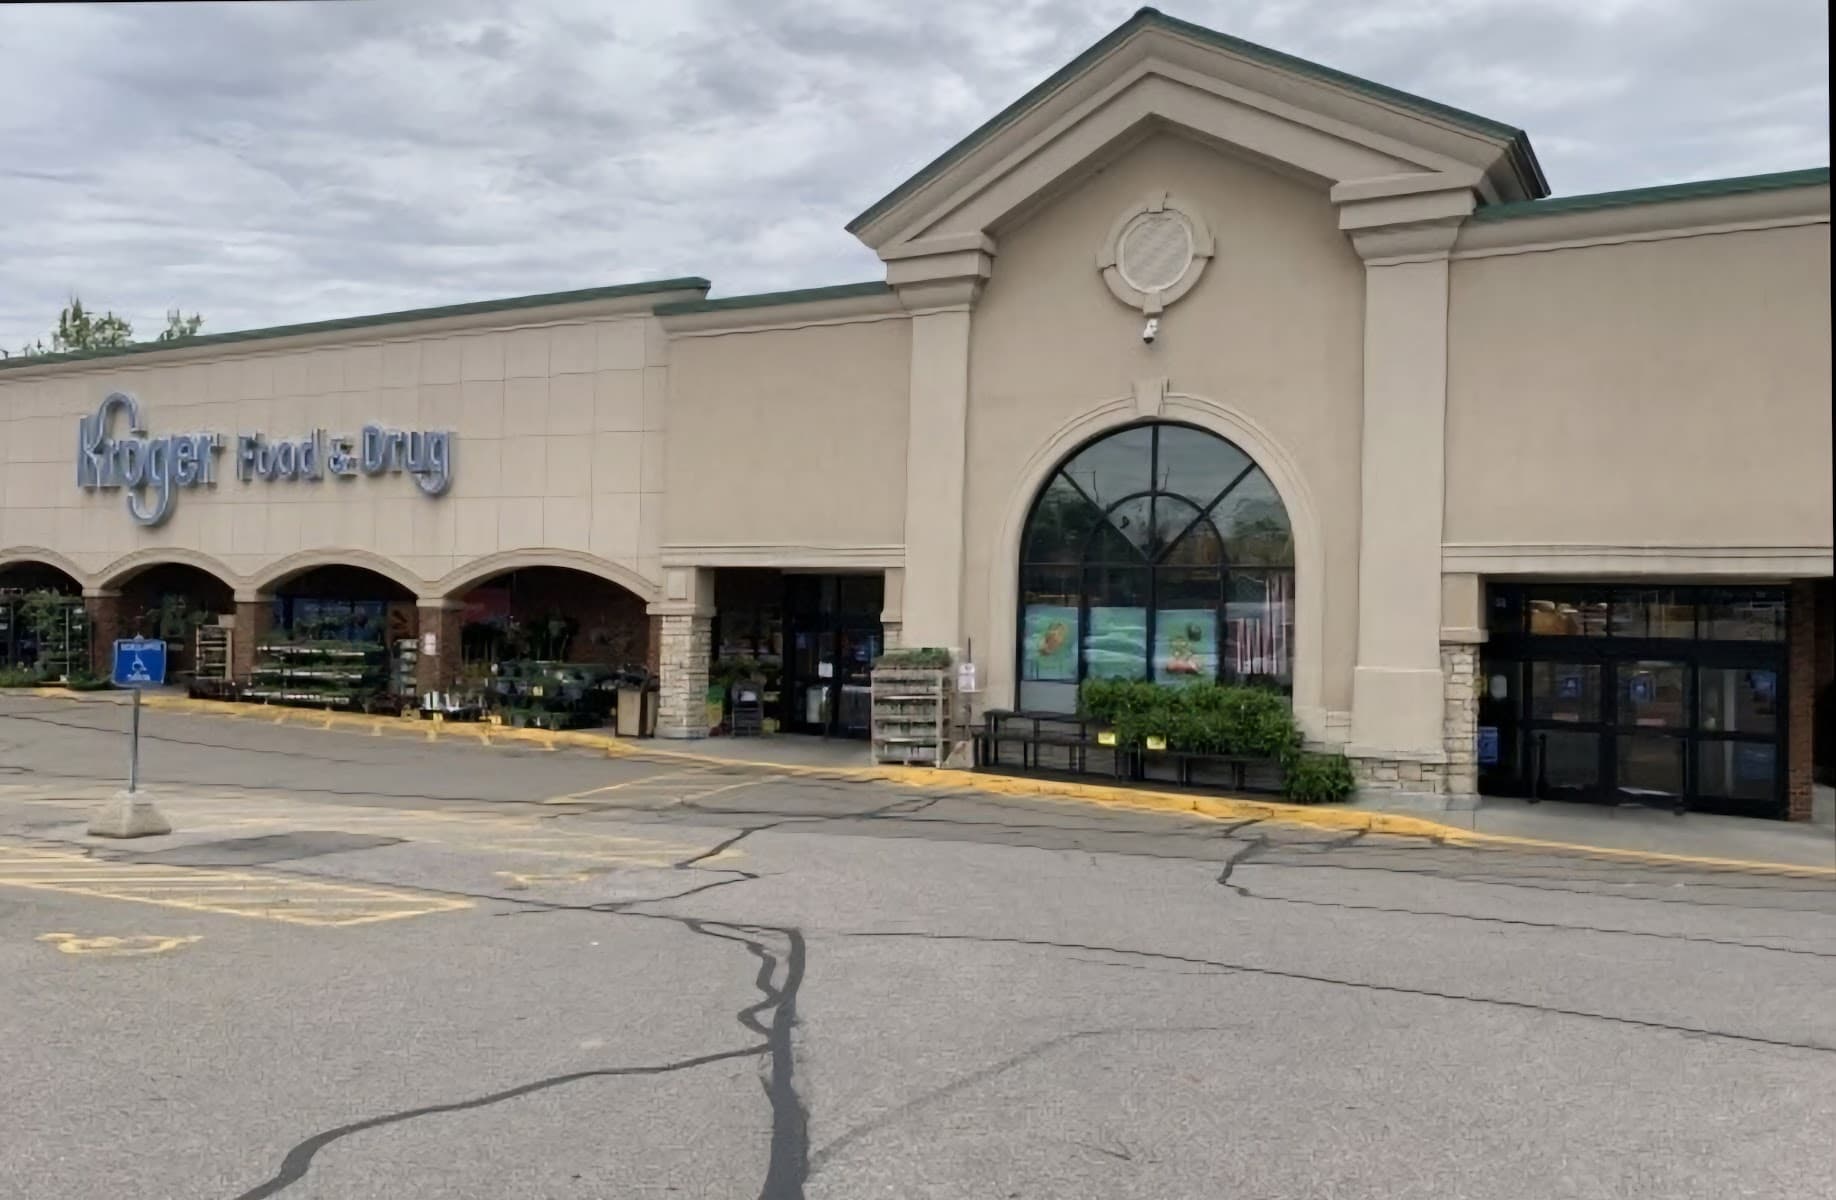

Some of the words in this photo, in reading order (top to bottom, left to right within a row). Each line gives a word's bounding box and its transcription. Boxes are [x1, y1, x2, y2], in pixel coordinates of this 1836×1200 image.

[77, 392, 223, 526] Kroger
[237, 429, 325, 481] Food
[328, 437, 359, 478] &
[361, 423, 456, 496] Drug
